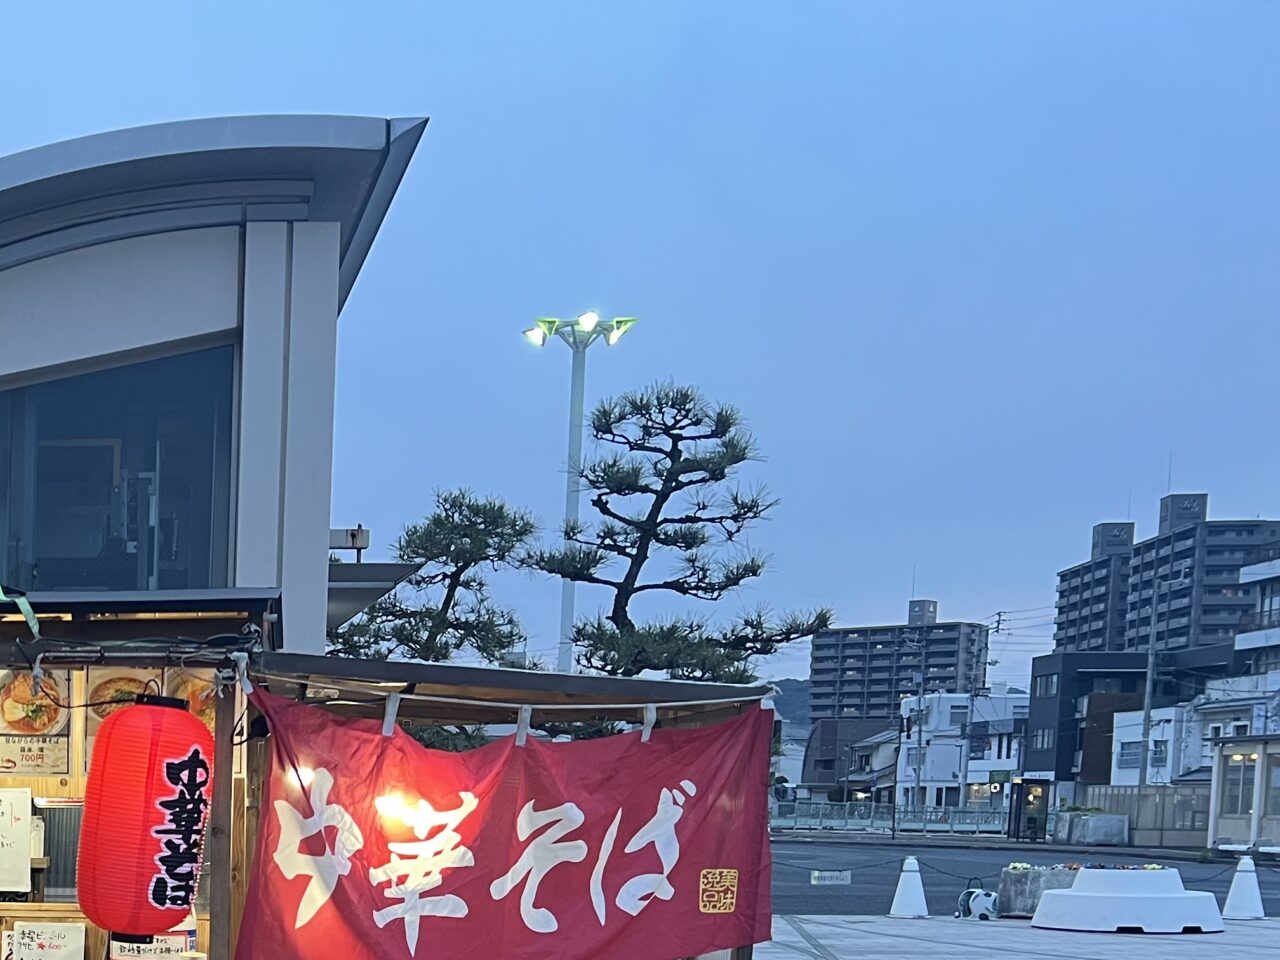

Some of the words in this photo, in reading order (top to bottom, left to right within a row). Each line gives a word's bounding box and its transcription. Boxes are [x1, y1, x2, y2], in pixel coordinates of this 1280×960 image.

[20, 754, 45, 763] 700円
[273, 767, 697, 957] 中華そば
